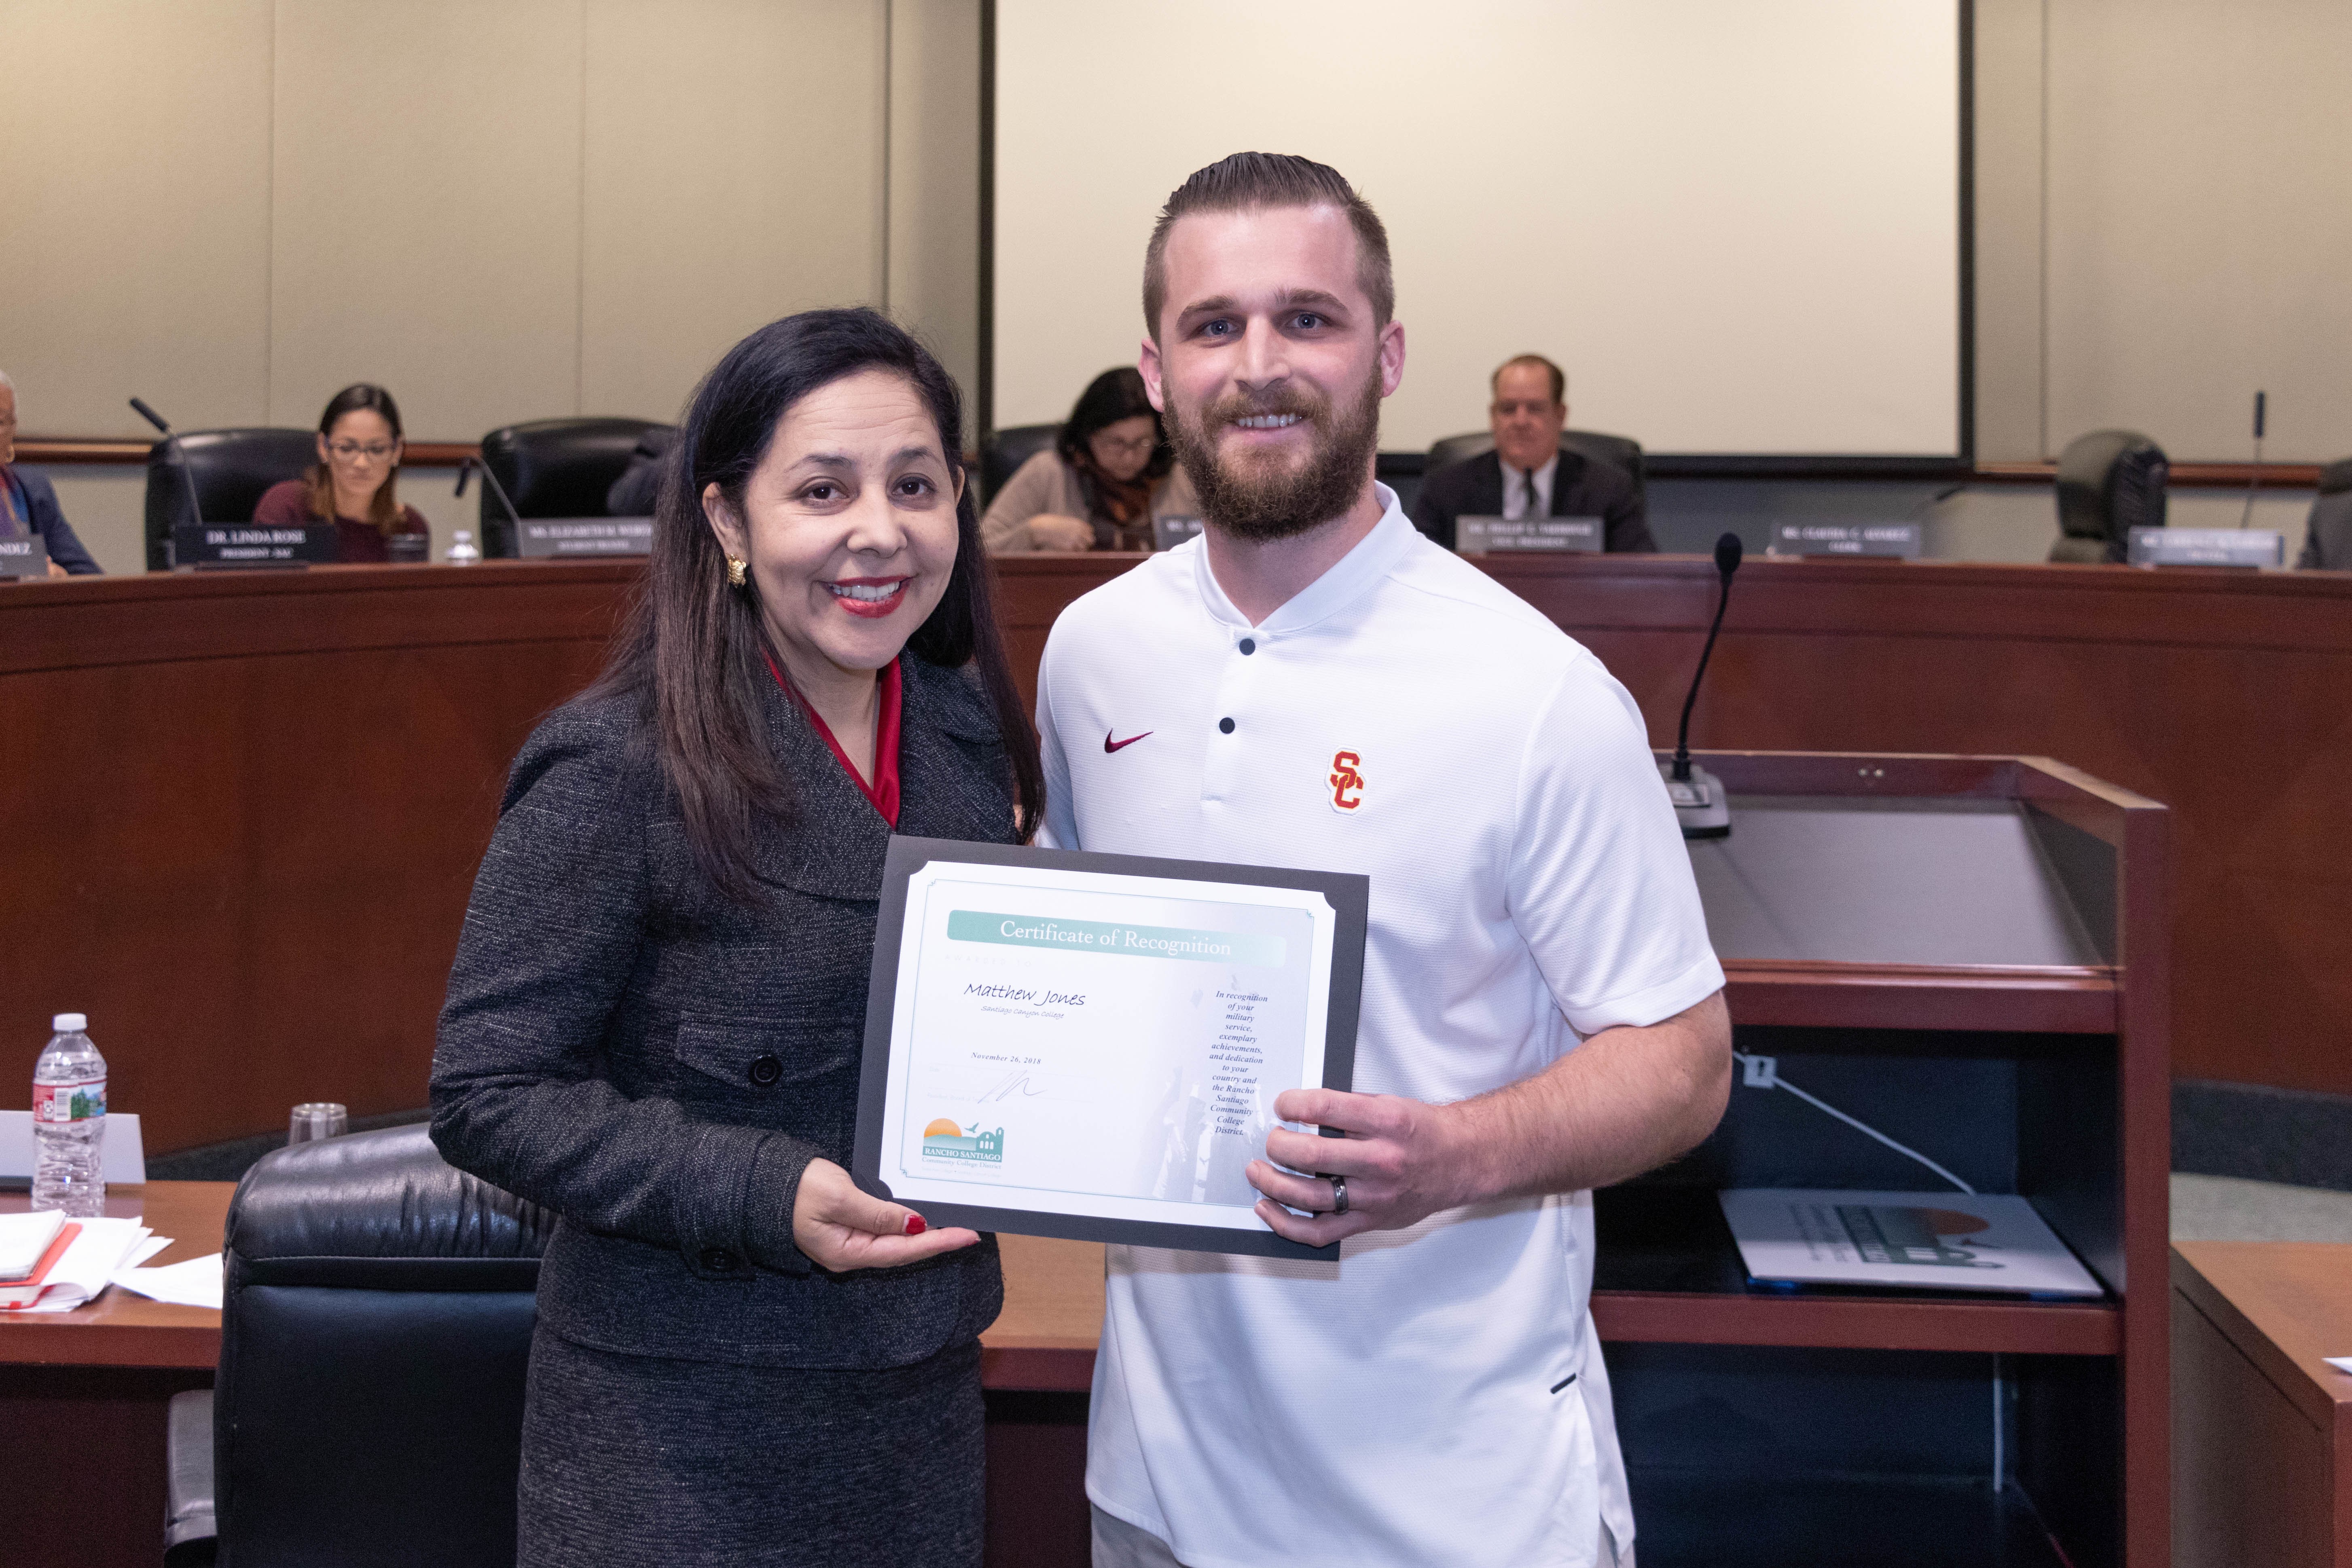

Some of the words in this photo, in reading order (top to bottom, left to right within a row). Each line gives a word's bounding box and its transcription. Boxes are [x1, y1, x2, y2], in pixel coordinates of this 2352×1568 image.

[229, 529, 272, 544] LINDA
[271, 529, 306, 544] ROSE
[1330, 751, 1364, 809] SC
[1000, 920, 1093, 944] Certificate
[1100, 928, 1119, 946] of
[1126, 931, 1231, 956] Recognition
[964, 983, 1037, 1001] Matthew
[1034, 990, 1086, 1006] Jones
[1226, 993, 1268, 1002] recognition
[981, 1005, 1012, 1014] Santiago
[1014, 1009, 1039, 1018] Canyon
[1042, 1011, 1064, 1020] College
[1226, 1013, 1255, 1023] military
[1225, 1024, 1252, 1032] service,
[1219, 1034, 1257, 1044] exemplary
[1212, 1043, 1262, 1054] achievements,
[971, 1052, 1007, 1062] November
[1226, 1054, 1263, 1064] dedication
[1213, 1075, 1241, 1083] country
[1226, 1085, 1254, 1094] Rancho
[1216, 1094, 1249, 1105] Santiago
[1211, 1105, 1253, 1116] Community
[1217, 1115, 1245, 1126] College
[1215, 1126, 1243, 1135] District.
[925, 1148, 959, 1157] RANCHO
[960, 1151, 1001, 1161] SANTIAGO
[922, 1157, 955, 1166] Community
